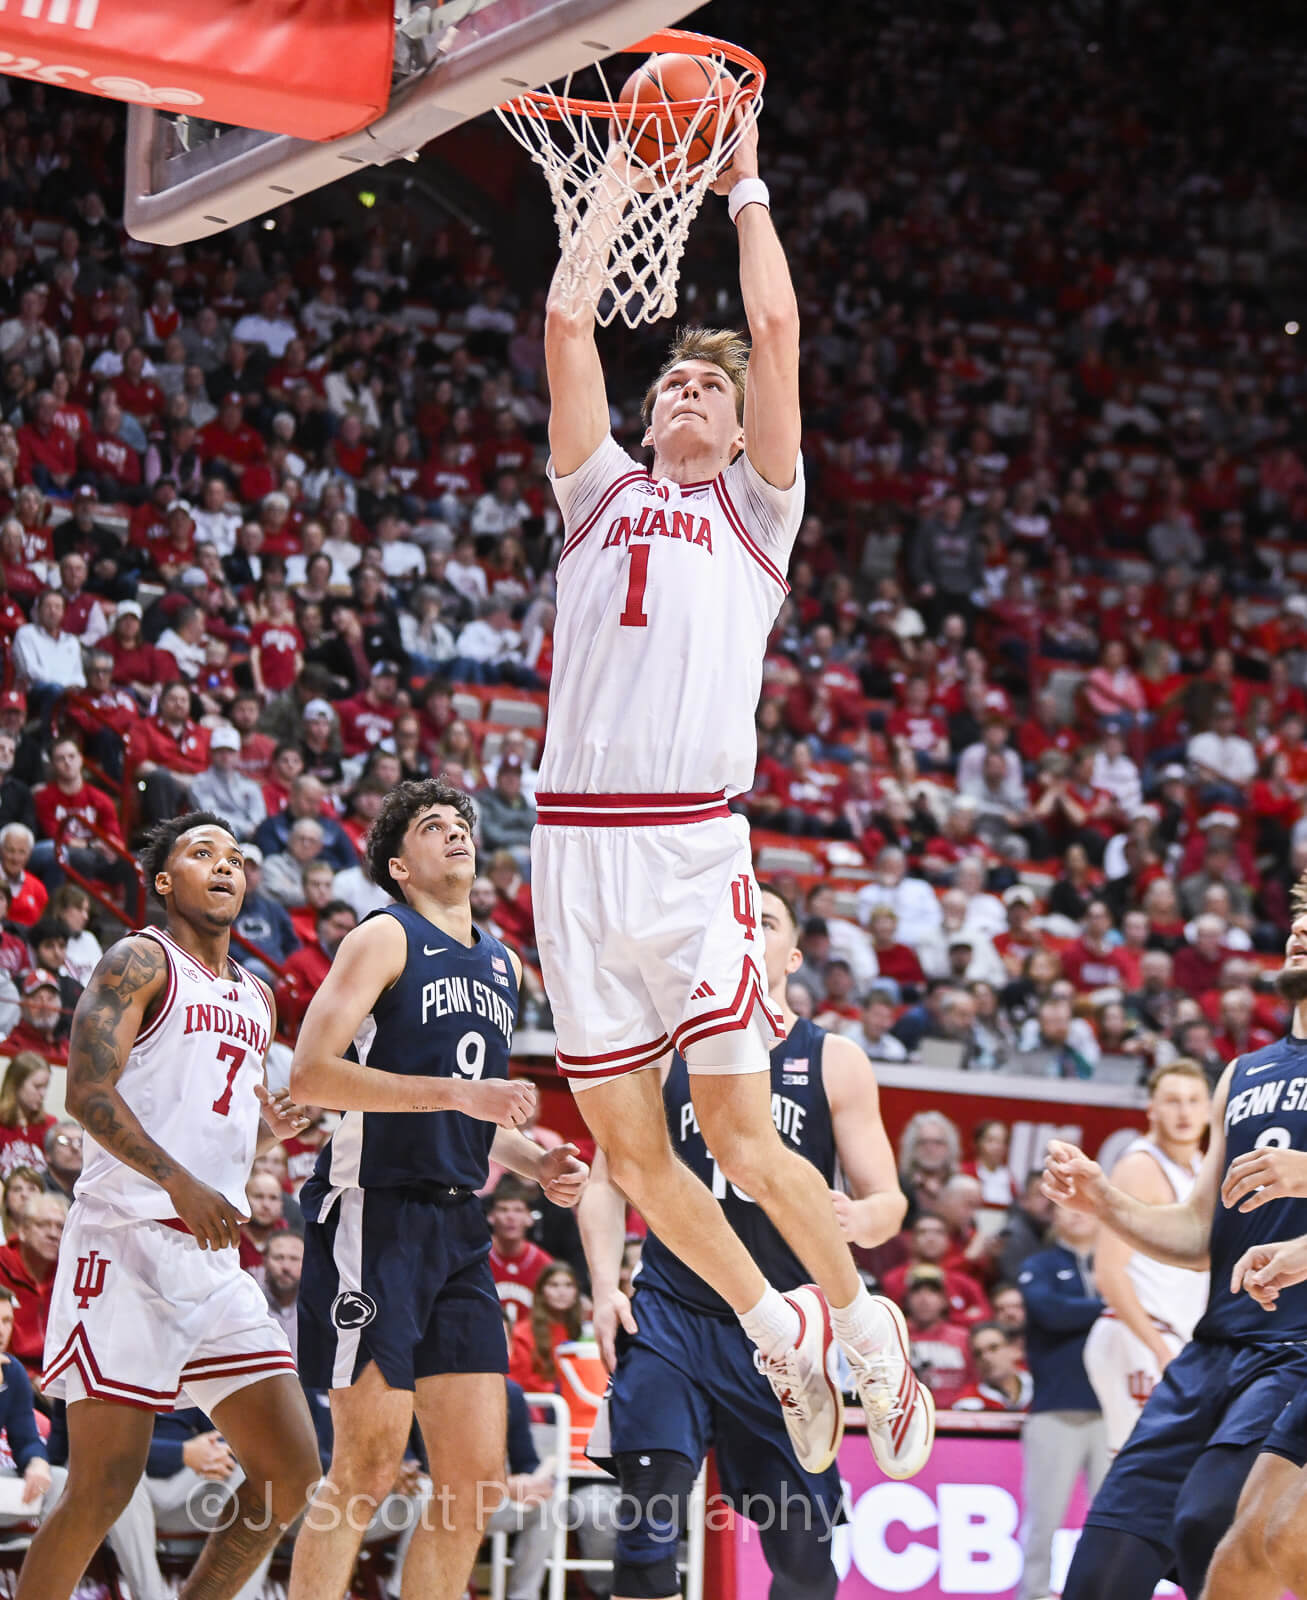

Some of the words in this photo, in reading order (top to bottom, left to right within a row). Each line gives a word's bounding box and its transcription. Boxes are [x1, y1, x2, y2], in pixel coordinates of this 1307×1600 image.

[601, 506, 713, 556] INIANA
[619, 543, 651, 627] 1
[422, 977, 472, 1025] PENN
[184, 1003, 268, 1056] INDIANA
[452, 1031, 486, 1080] 9
[212, 1041, 247, 1117] 7
[771, 1092, 807, 1146] ATE
[1224, 1080, 1286, 1137] PENN
